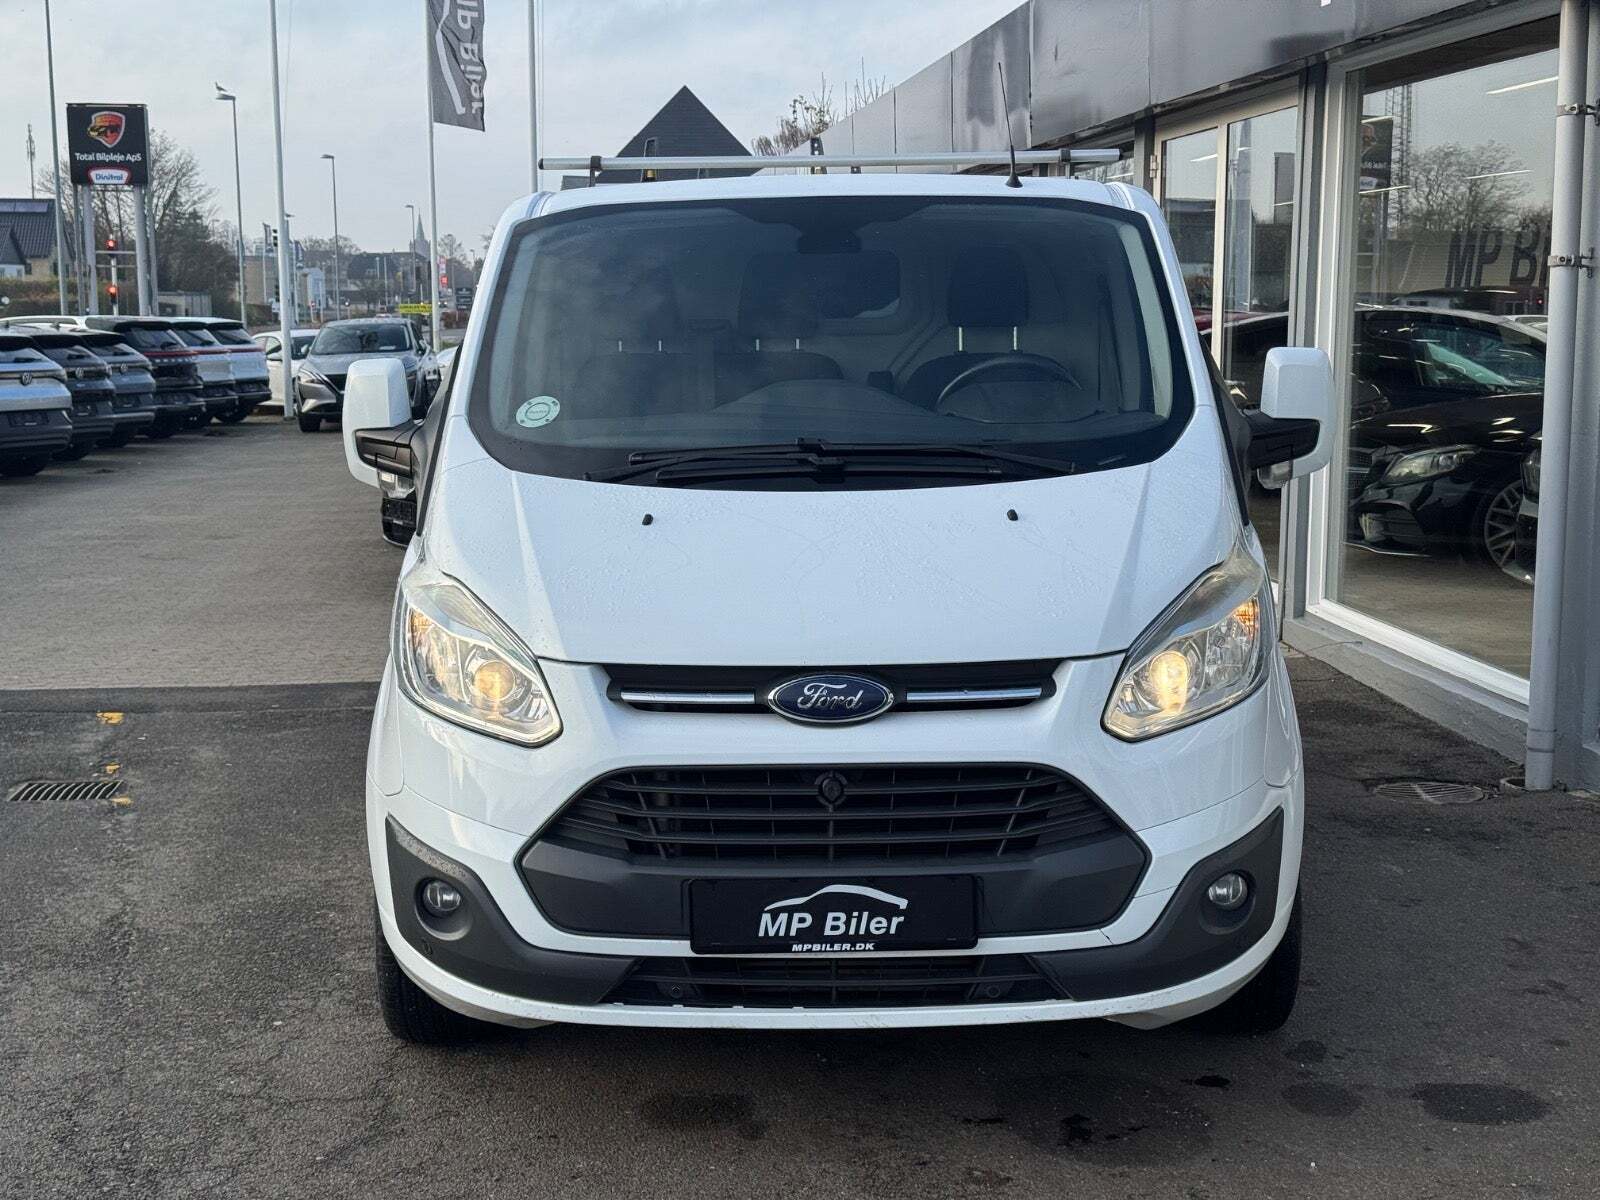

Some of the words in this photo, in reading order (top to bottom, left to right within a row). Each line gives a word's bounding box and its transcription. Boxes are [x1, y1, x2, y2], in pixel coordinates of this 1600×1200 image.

[75, 153, 95, 161] Total
[126, 153, 142, 163] ApS
[1445, 224, 1504, 288] MP
[797, 682, 864, 709] Ford
[758, 912, 812, 937] MP
[824, 911, 904, 936] Biler
[791, 942, 875, 952] MPBILER.DK
